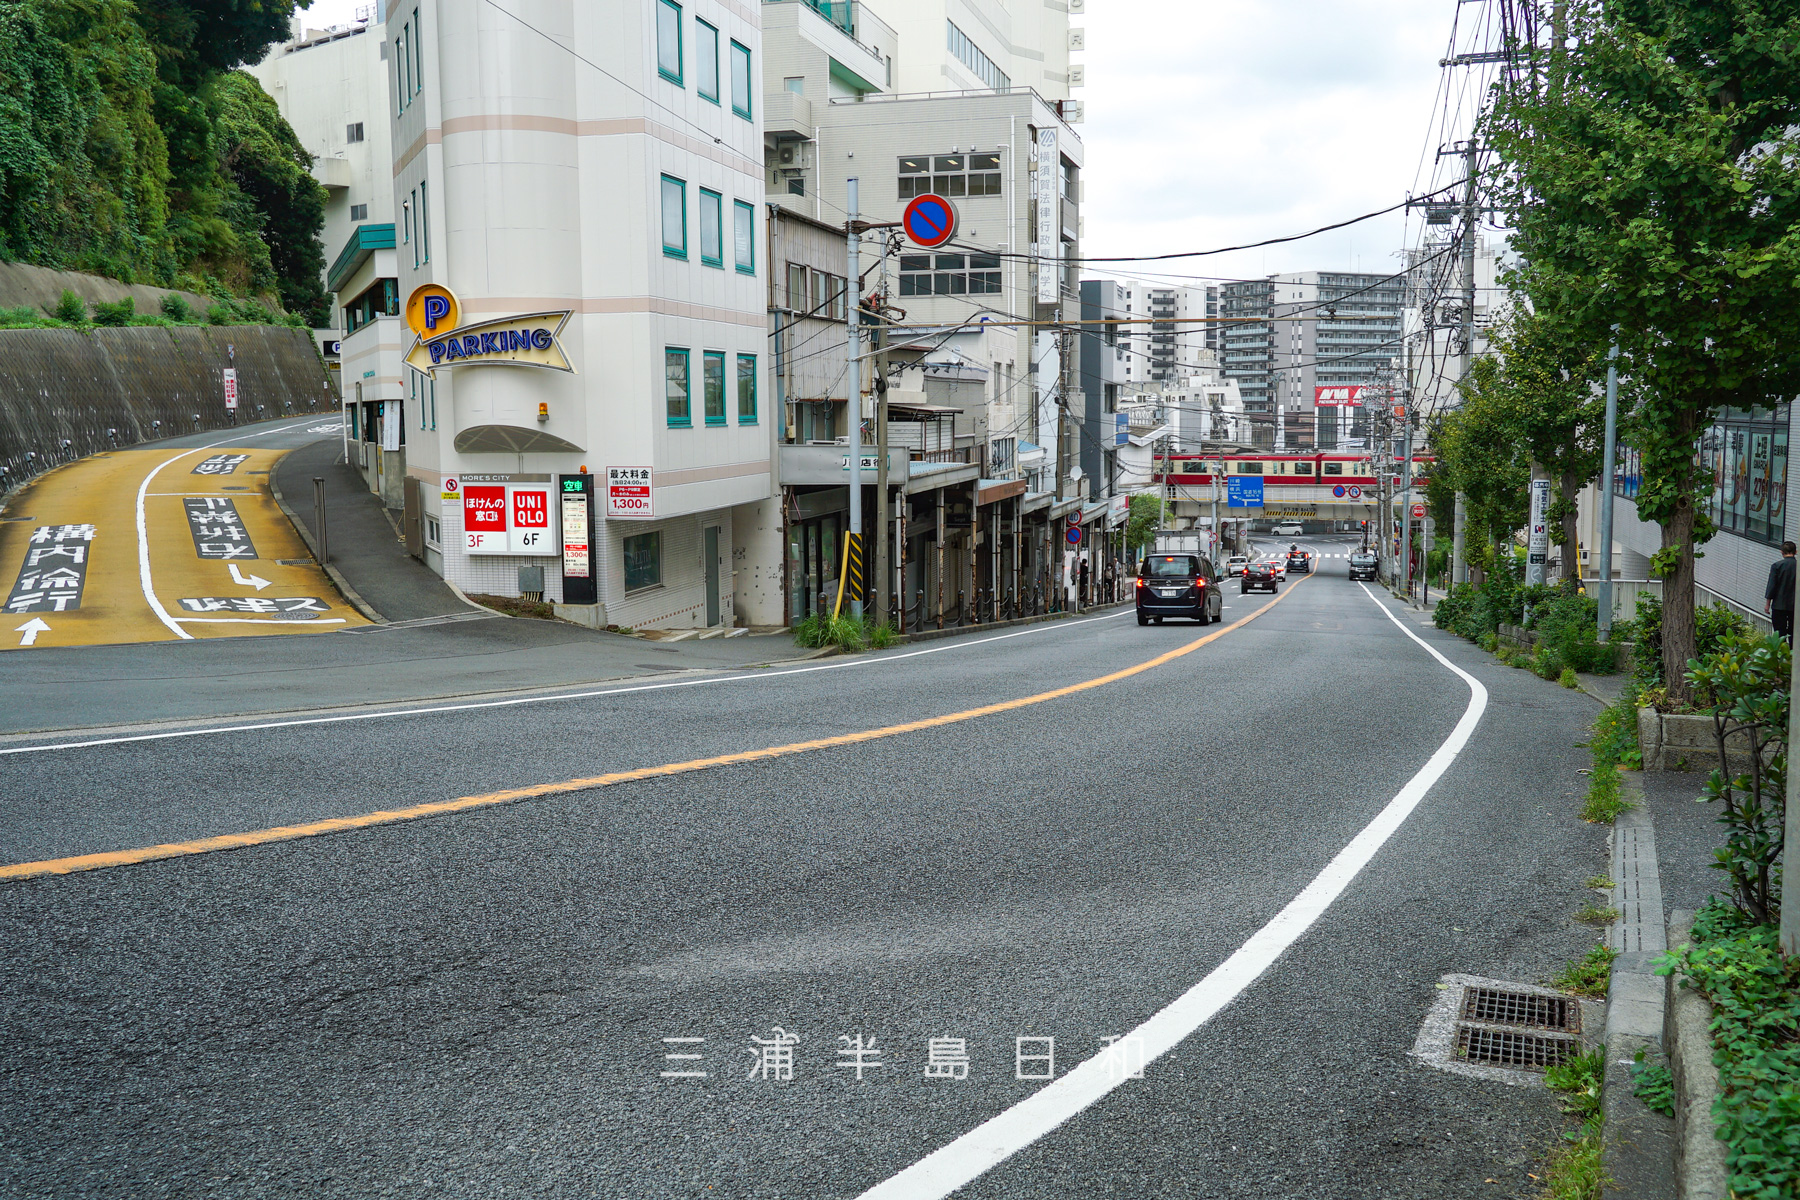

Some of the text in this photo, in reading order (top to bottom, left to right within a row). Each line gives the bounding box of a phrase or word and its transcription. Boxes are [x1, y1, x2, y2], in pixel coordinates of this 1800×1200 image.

[1039, 151, 1051, 300] 横須賀法律行政専門学校
[424, 295, 451, 330] P
[428, 328, 553, 364] PARKING
[195, 454, 247, 475] 徐行
[610, 469, 649, 479] 最大料金
[563, 480, 583, 491] 空車
[465, 497, 505, 509] ほけんの
[516, 495, 541, 509] UNI
[612, 498, 649, 509] 1,300円
[517, 510, 544, 525] QLO
[1069, 513, 1078, 521] 40
[185, 497, 254, 560] 右折禁止
[467, 534, 484, 548] 3F
[523, 533, 539, 546] 6F
[8, 523, 98, 614] 構内徐行
[181, 597, 329, 613] とまれ
